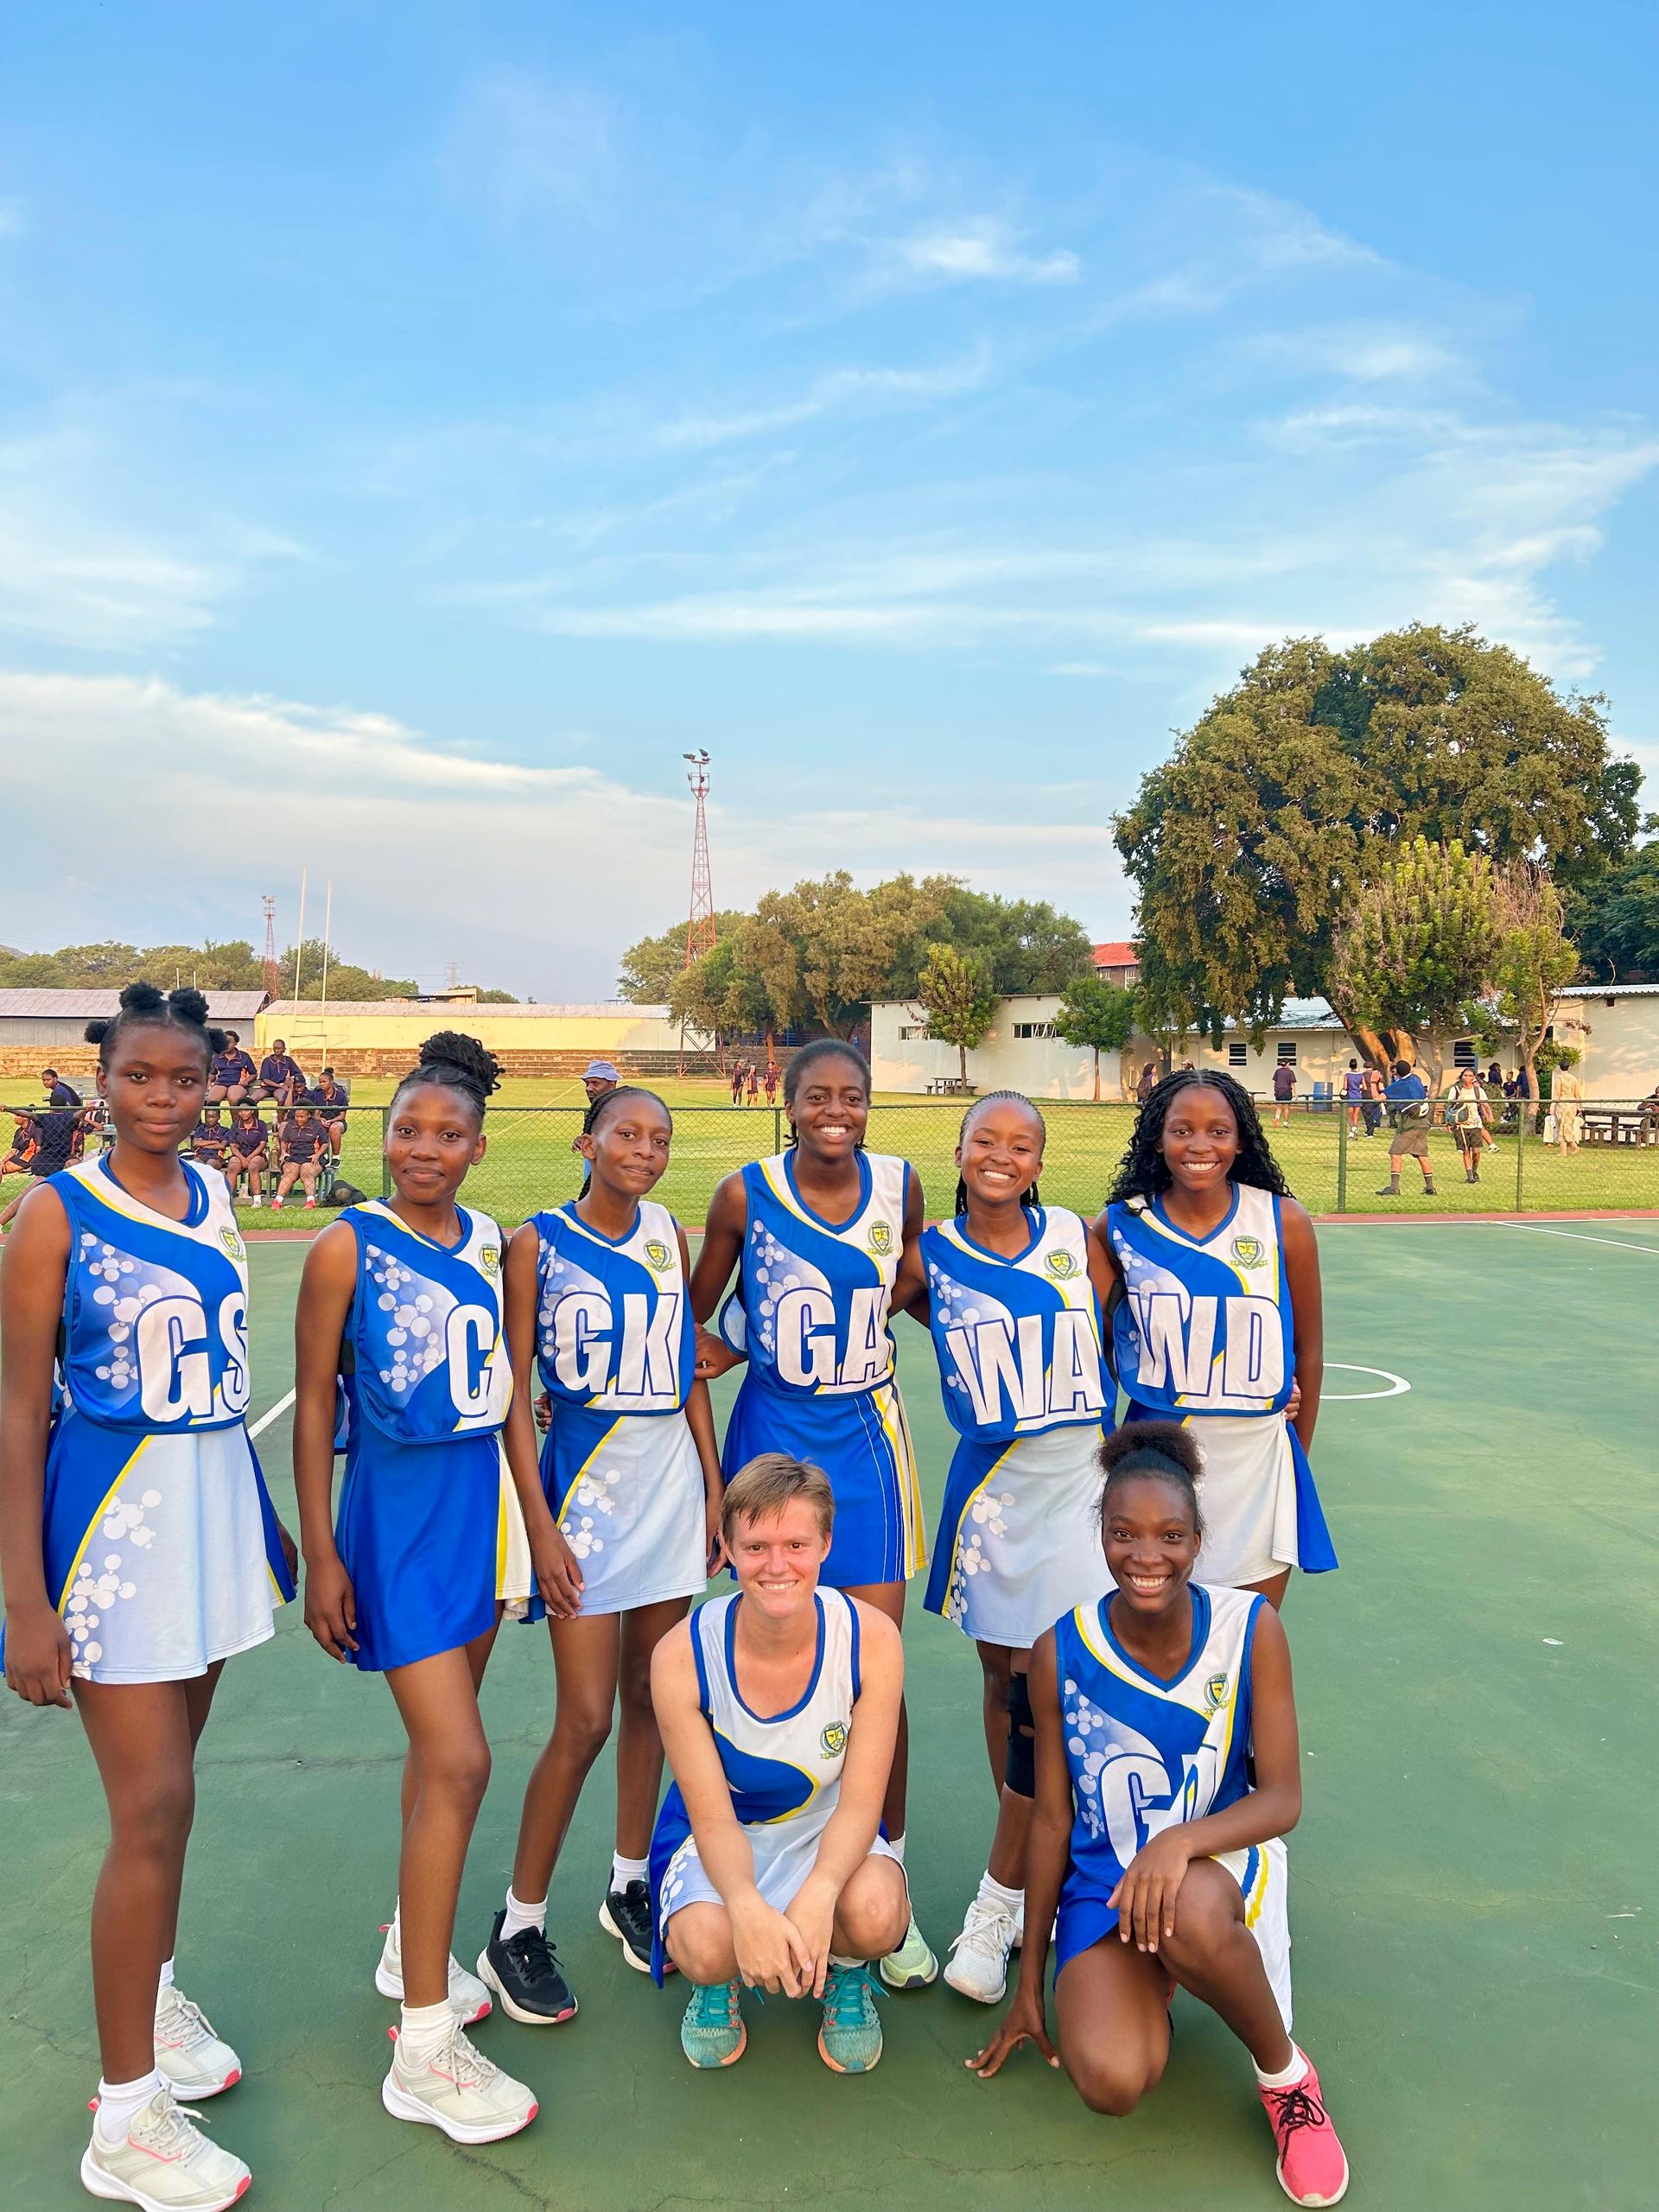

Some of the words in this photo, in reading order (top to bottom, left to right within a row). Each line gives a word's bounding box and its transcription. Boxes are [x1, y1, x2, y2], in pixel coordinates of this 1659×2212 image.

[134, 1292, 250, 1423] GS
[444, 1303, 493, 1419] C
[554, 1291, 680, 1396] GK
[776, 1285, 893, 1386] GA
[945, 1308, 1107, 1427] WA
[1127, 1293, 1285, 1399] WD
